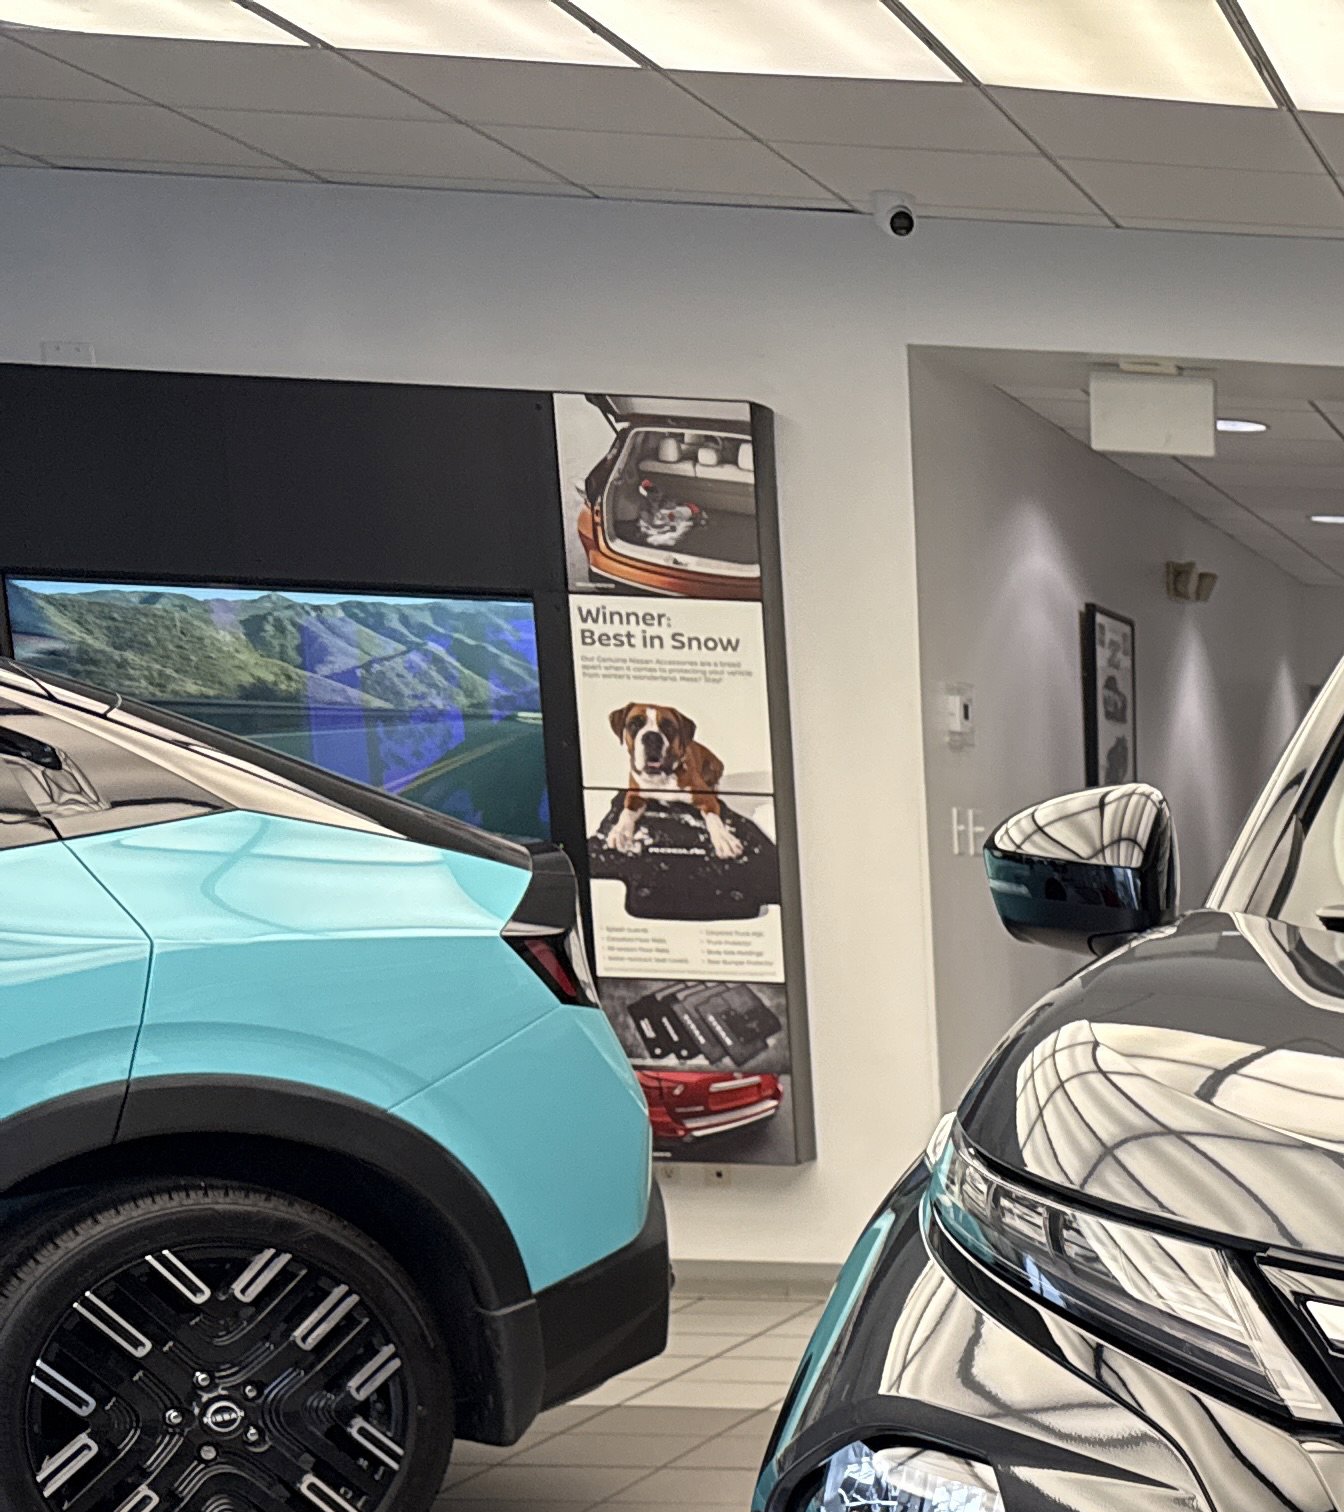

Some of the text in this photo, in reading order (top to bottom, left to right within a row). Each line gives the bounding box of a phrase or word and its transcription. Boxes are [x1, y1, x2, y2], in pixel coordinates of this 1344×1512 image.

[577, 604, 672, 628] Winner:
[580, 628, 741, 653] Best in Snow
